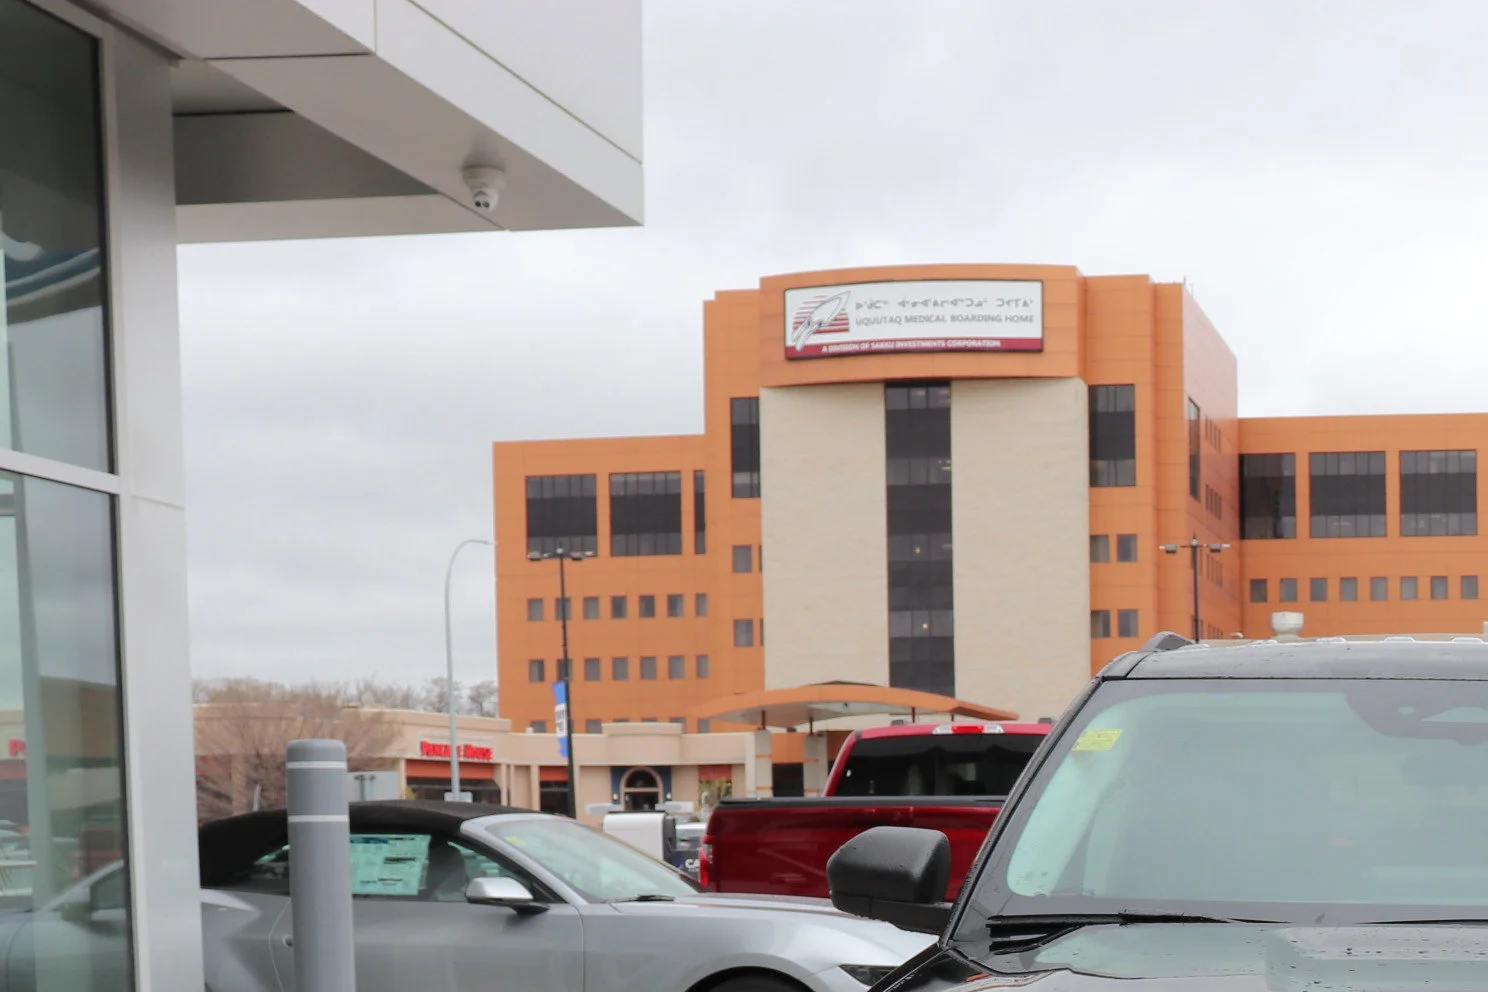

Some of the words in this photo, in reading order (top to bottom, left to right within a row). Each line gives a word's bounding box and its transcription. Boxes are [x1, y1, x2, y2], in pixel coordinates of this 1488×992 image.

[904, 314, 945, 323] MEDICAL
[951, 314, 1002, 322] BOARDING
[1005, 314, 1034, 322] HOME
[421, 741, 463, 758] PANCAE
[464, 744, 493, 760] HOUSE
